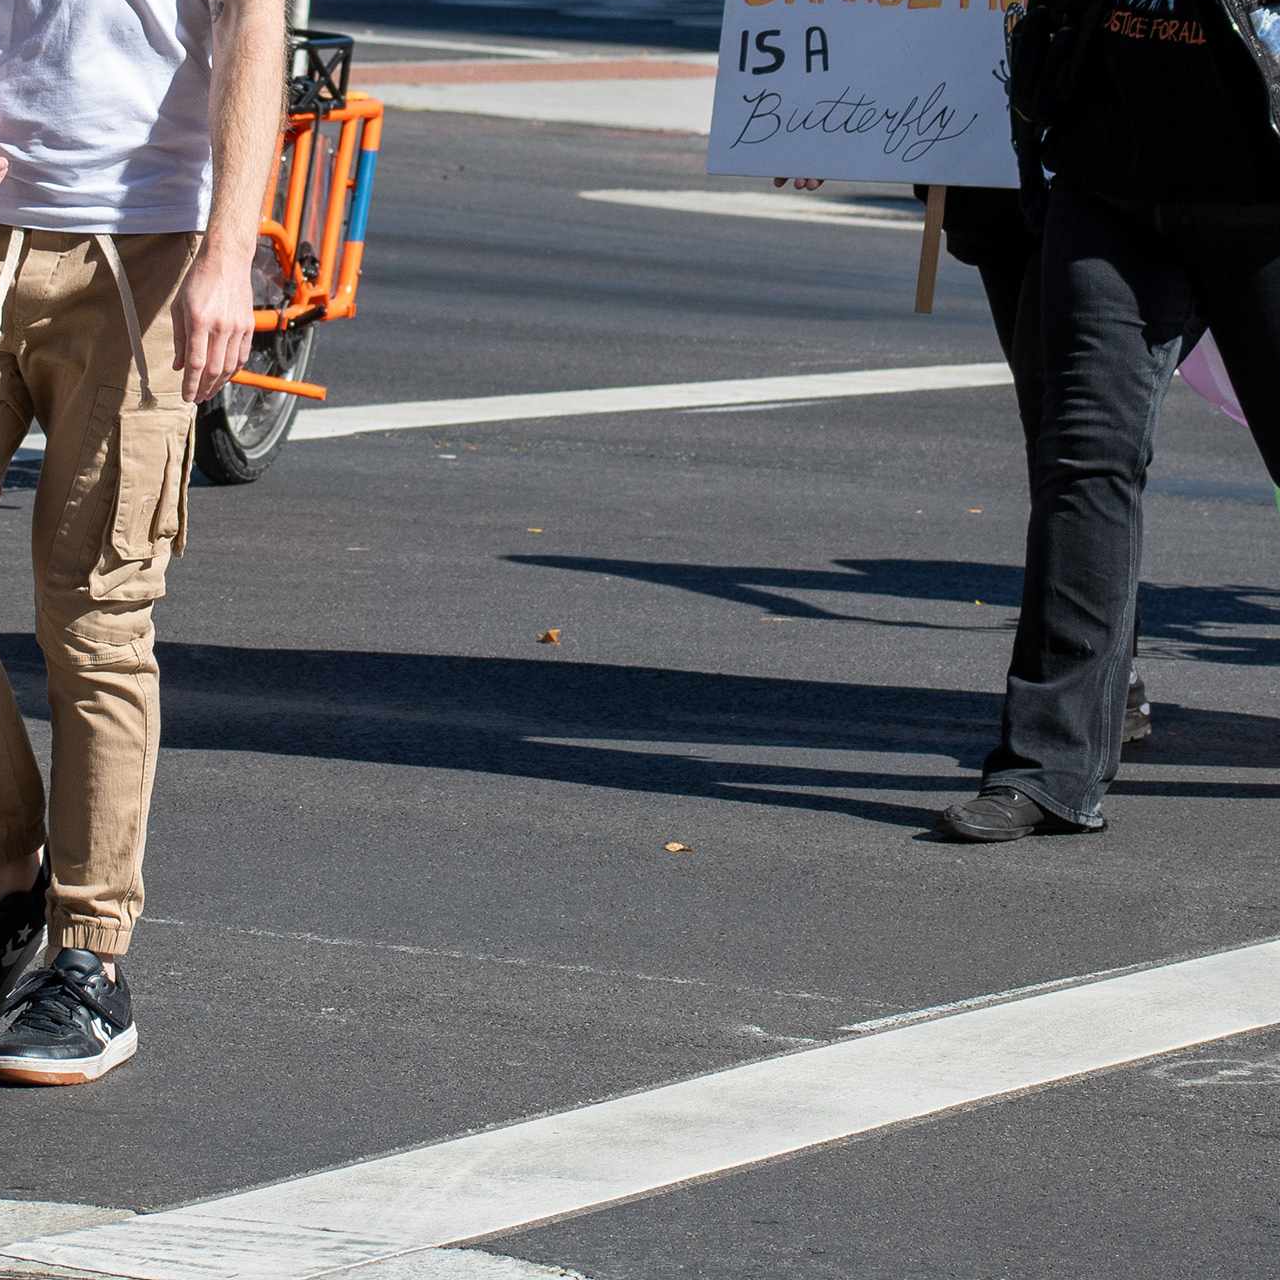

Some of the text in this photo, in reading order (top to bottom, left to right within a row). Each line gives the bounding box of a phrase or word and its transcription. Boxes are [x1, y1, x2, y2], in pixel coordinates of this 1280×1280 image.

[739, 27, 829, 75] IS A
[1101, 9, 1206, 45] USTICE FOR ALL
[730, 82, 978, 162] Butterfly
